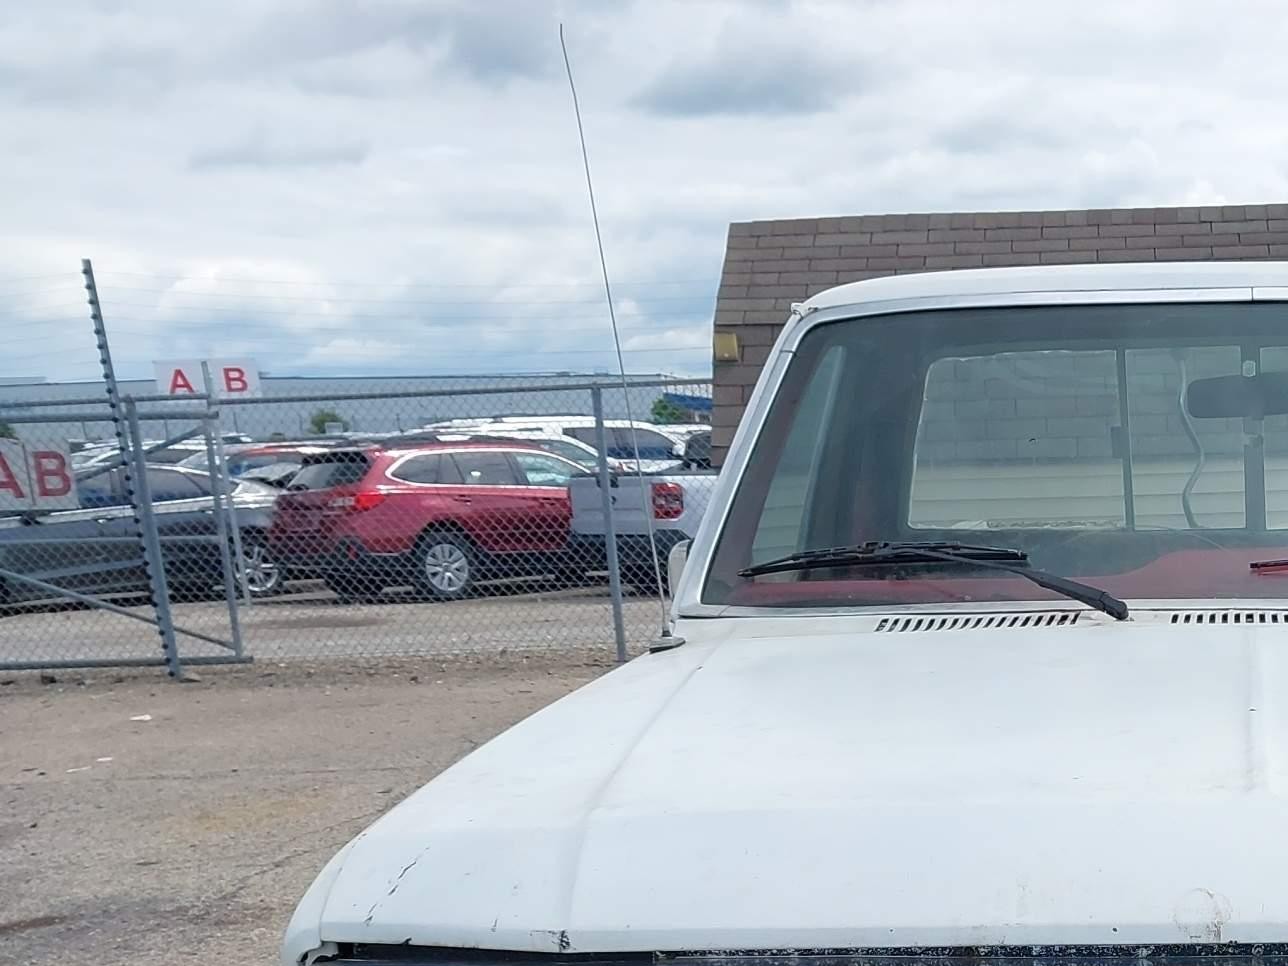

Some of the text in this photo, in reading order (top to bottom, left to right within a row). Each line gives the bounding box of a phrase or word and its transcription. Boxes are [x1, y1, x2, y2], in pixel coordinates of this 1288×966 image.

[169, 367, 249, 394] A B
[32, 451, 72, 497] B
